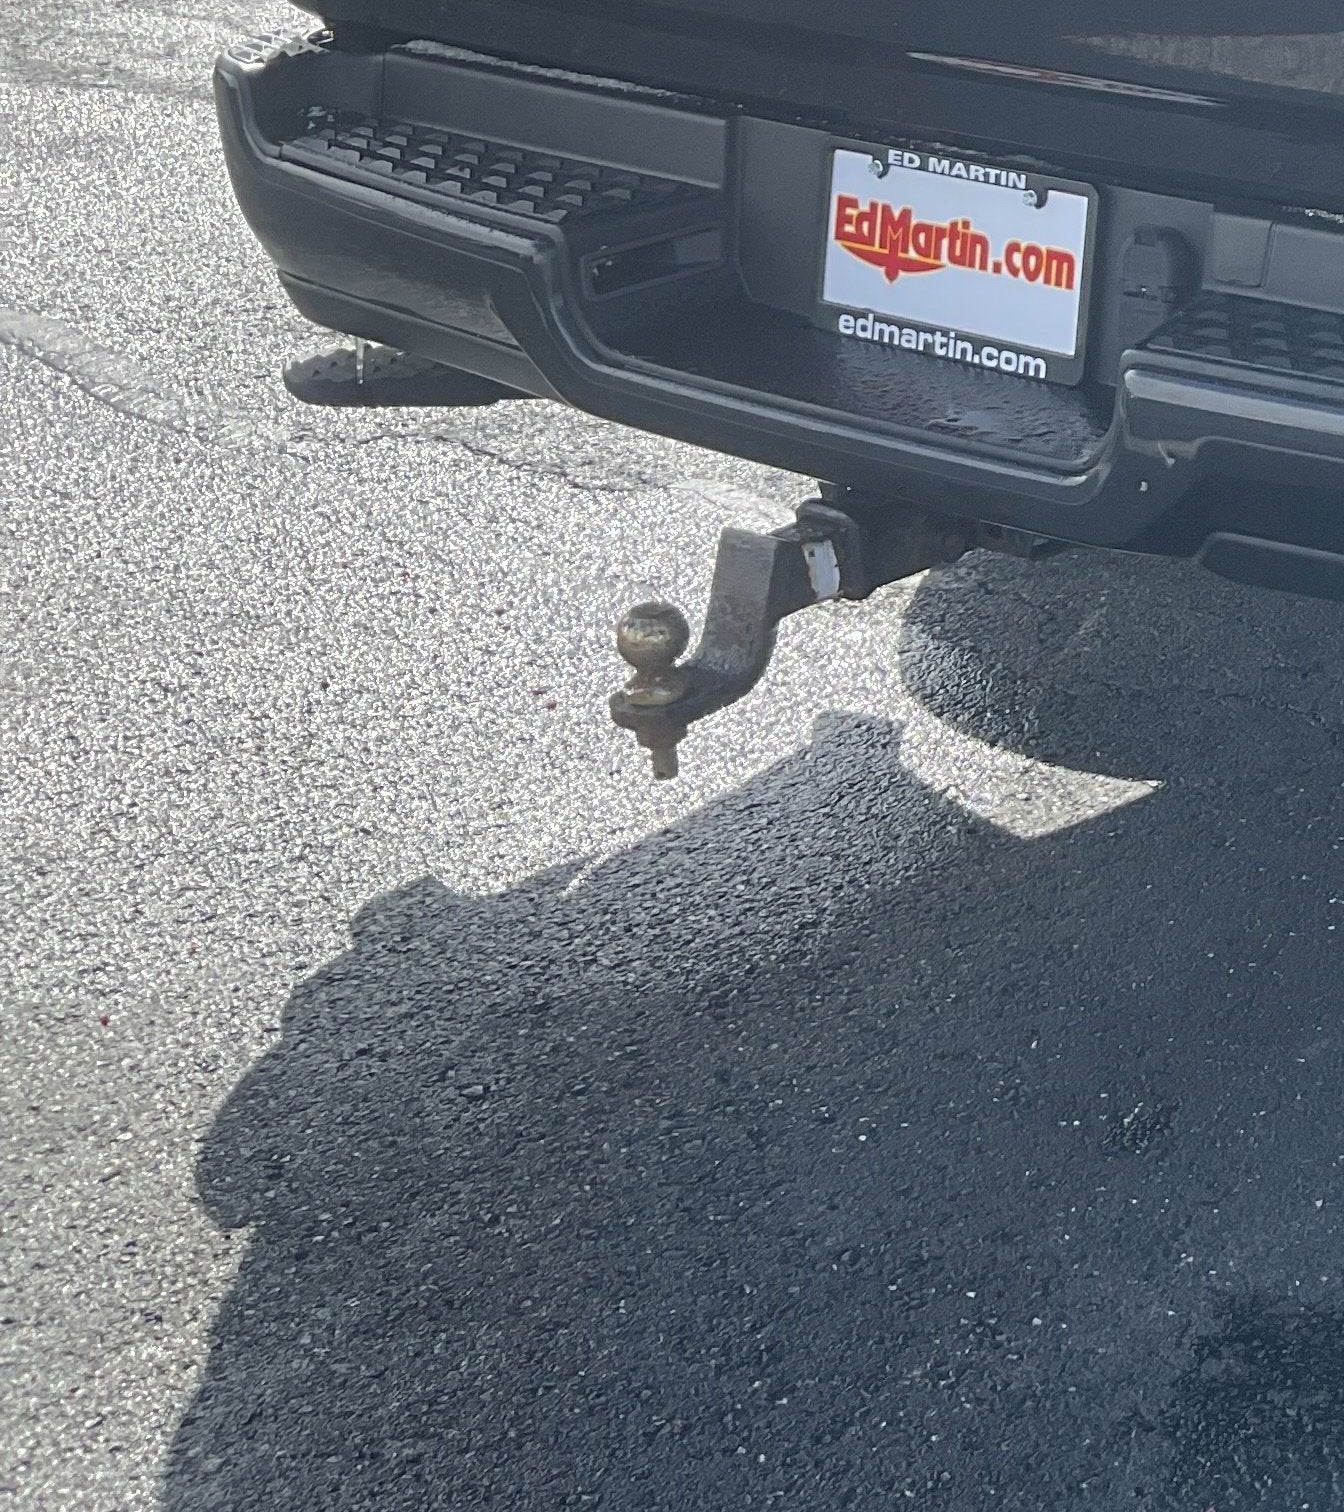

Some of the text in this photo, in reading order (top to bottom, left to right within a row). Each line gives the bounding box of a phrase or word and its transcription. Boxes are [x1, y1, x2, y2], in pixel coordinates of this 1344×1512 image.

[887, 148, 1027, 190] ED MARTIN
[837, 312, 1048, 379] edmartin.com
